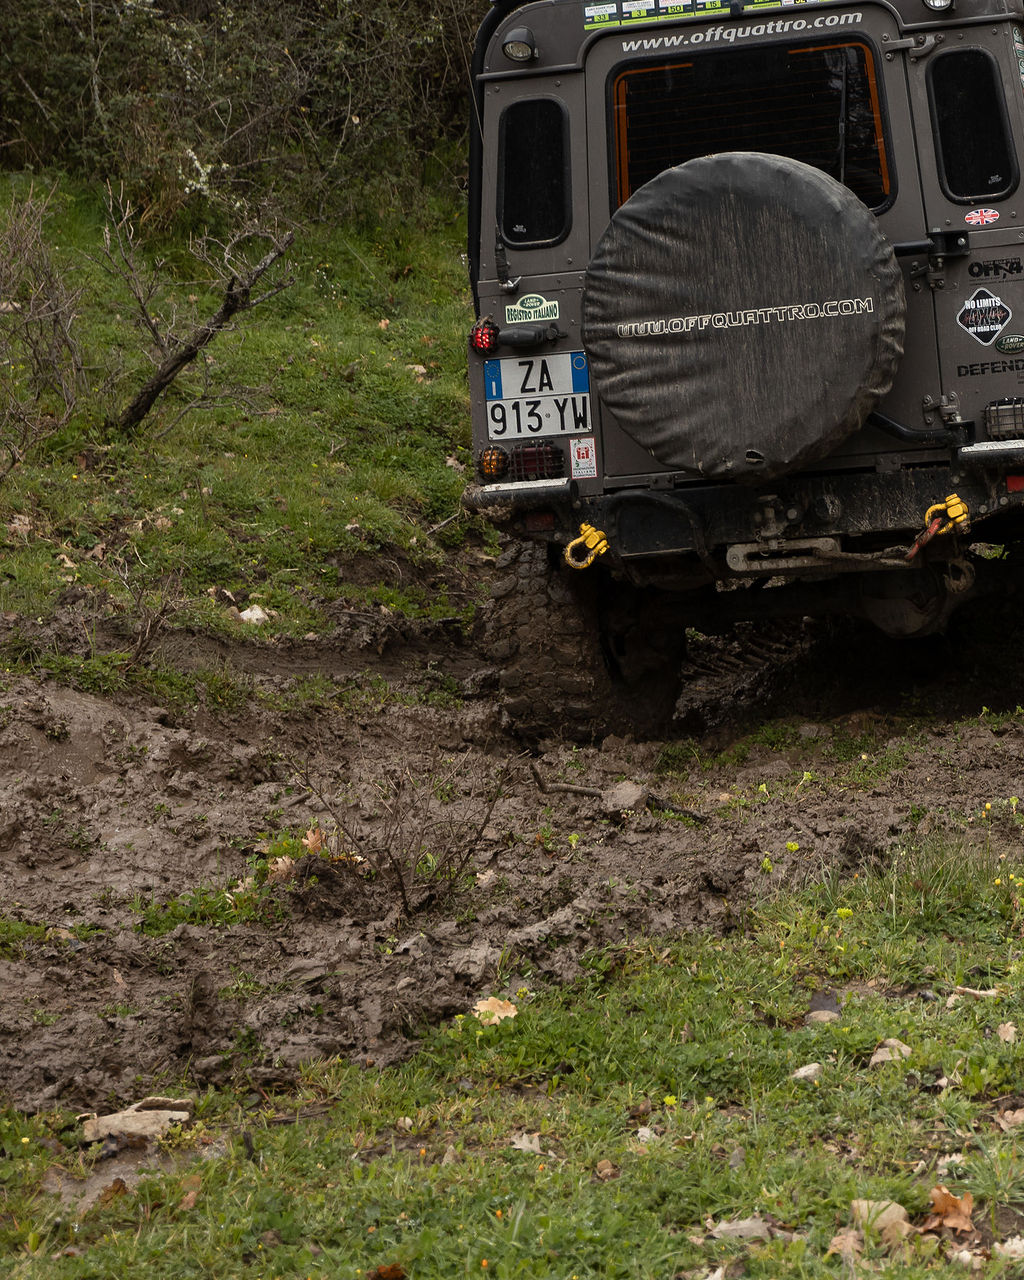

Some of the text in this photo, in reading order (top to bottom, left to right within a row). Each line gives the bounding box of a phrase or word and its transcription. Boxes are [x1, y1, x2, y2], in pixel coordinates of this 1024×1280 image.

[636, 9, 642, 17] 3
[621, 10, 863, 52] www.offquattro.com
[964, 296, 1001, 310] NO LIMITS
[507, 304, 558, 322] REGISTRO ITALIANO
[1004, 342, 1024, 350] ROVER
[518, 359, 554, 394] ZA
[490, 395, 588, 435] 913 YW
